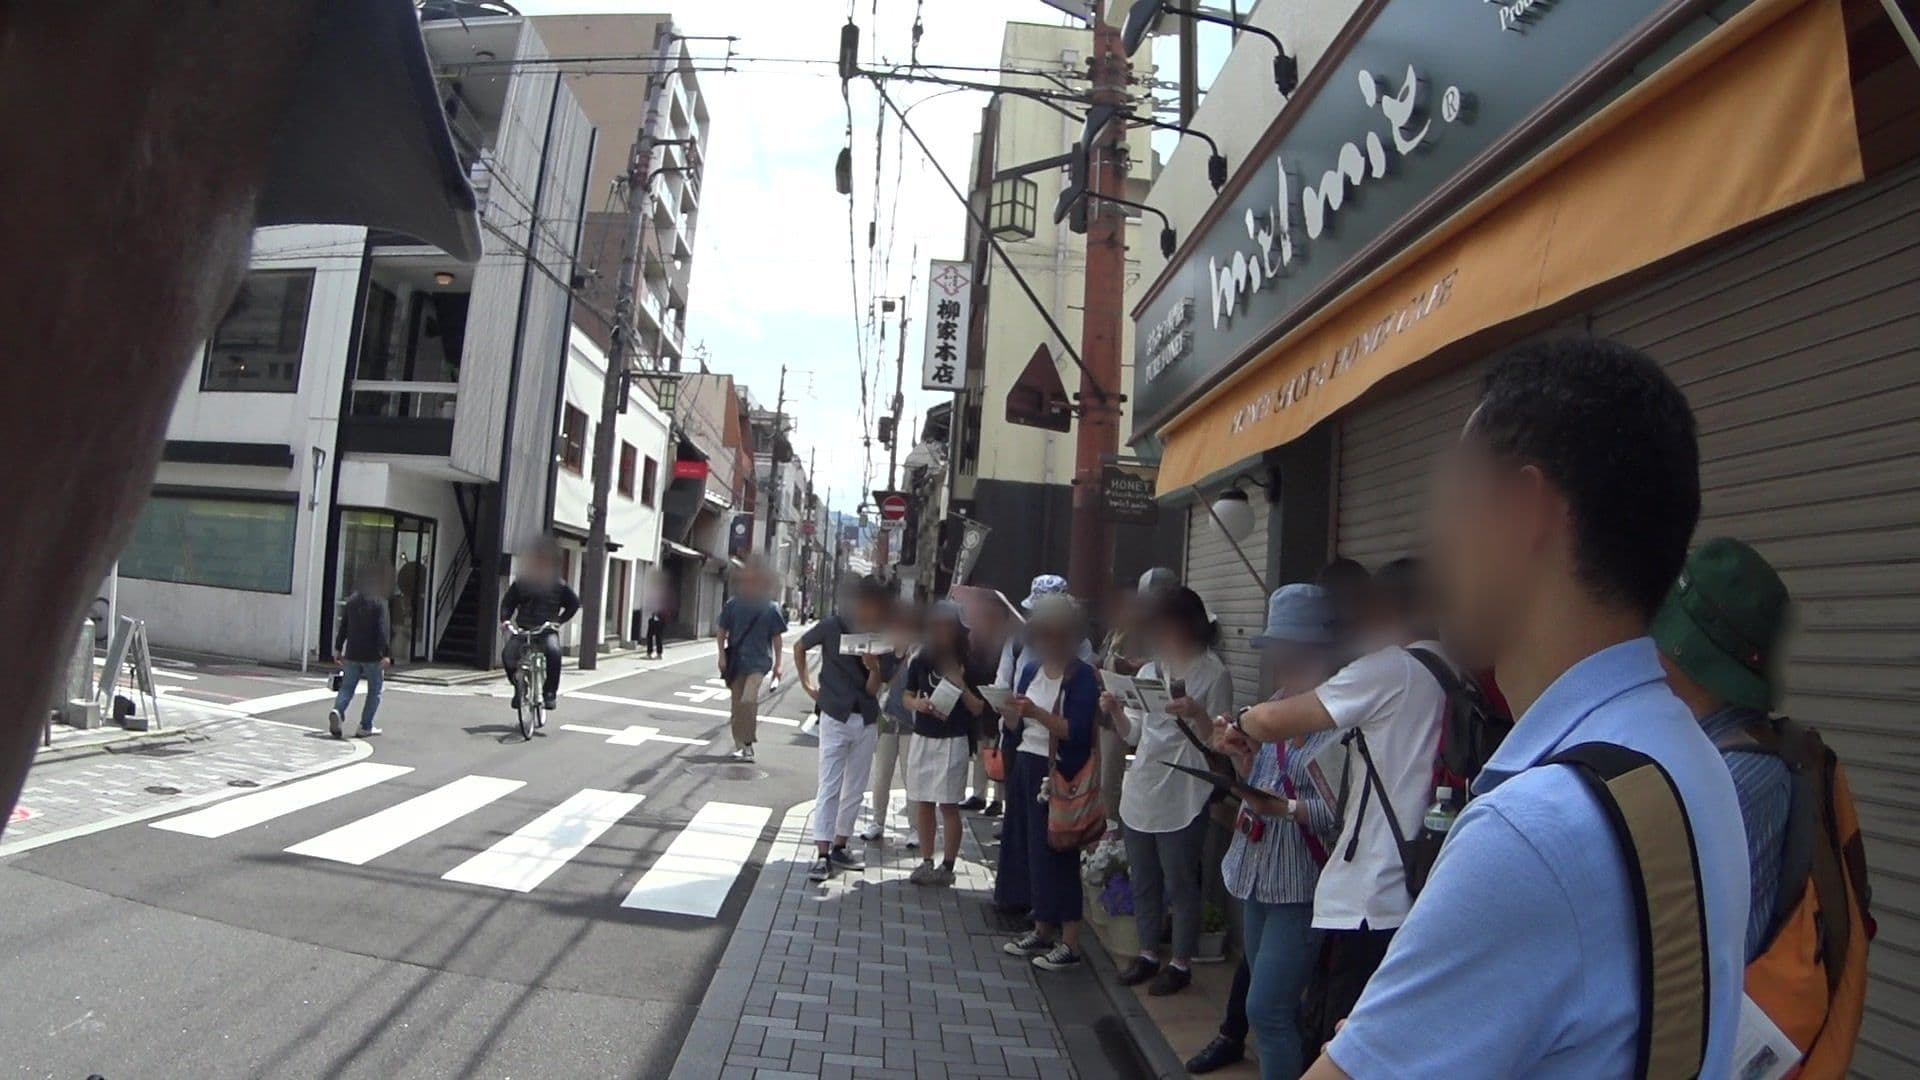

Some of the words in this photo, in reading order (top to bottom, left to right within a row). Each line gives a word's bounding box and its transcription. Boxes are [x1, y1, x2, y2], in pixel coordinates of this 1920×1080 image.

[931, 298, 961, 384] 柳家本店
[1329, 310, 1397, 380] HONEY
[1111, 479, 1151, 492] HONEY
